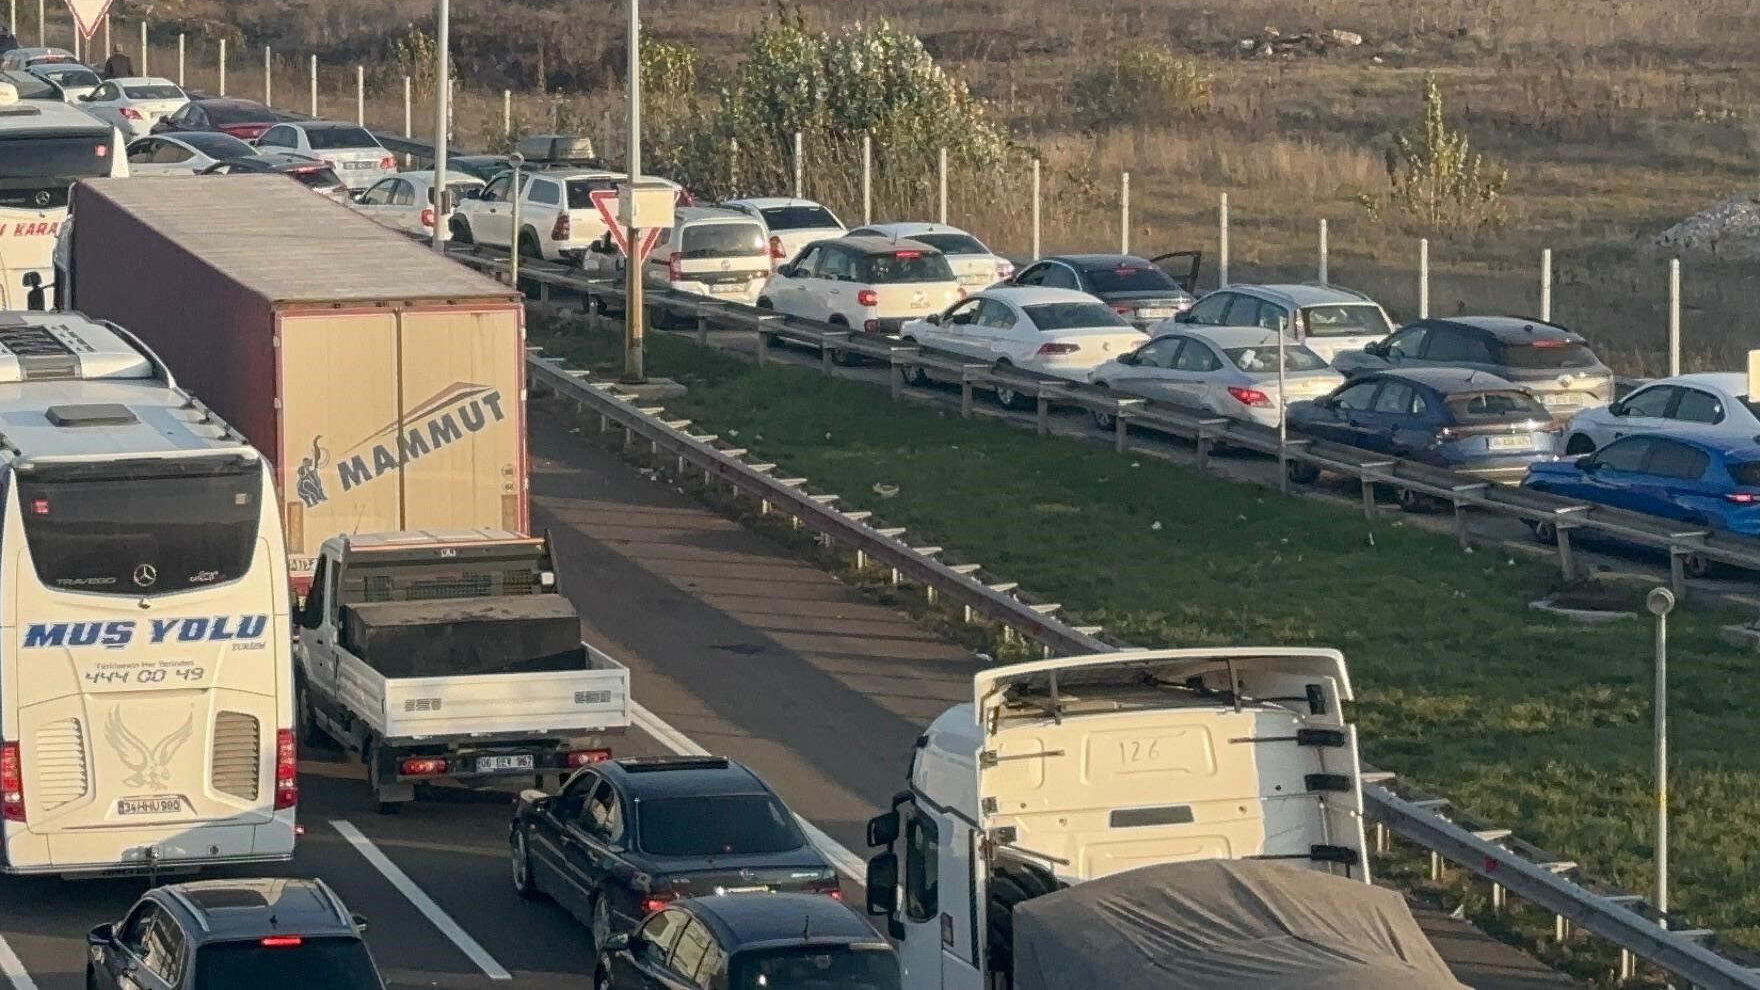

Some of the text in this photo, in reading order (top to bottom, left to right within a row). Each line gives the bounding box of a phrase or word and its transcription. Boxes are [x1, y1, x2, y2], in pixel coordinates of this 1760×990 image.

[337, 390, 505, 492] MAMMUT
[23, 613, 269, 650] MUŞ YOLU
[85, 666, 205, 684] 444 00 49
